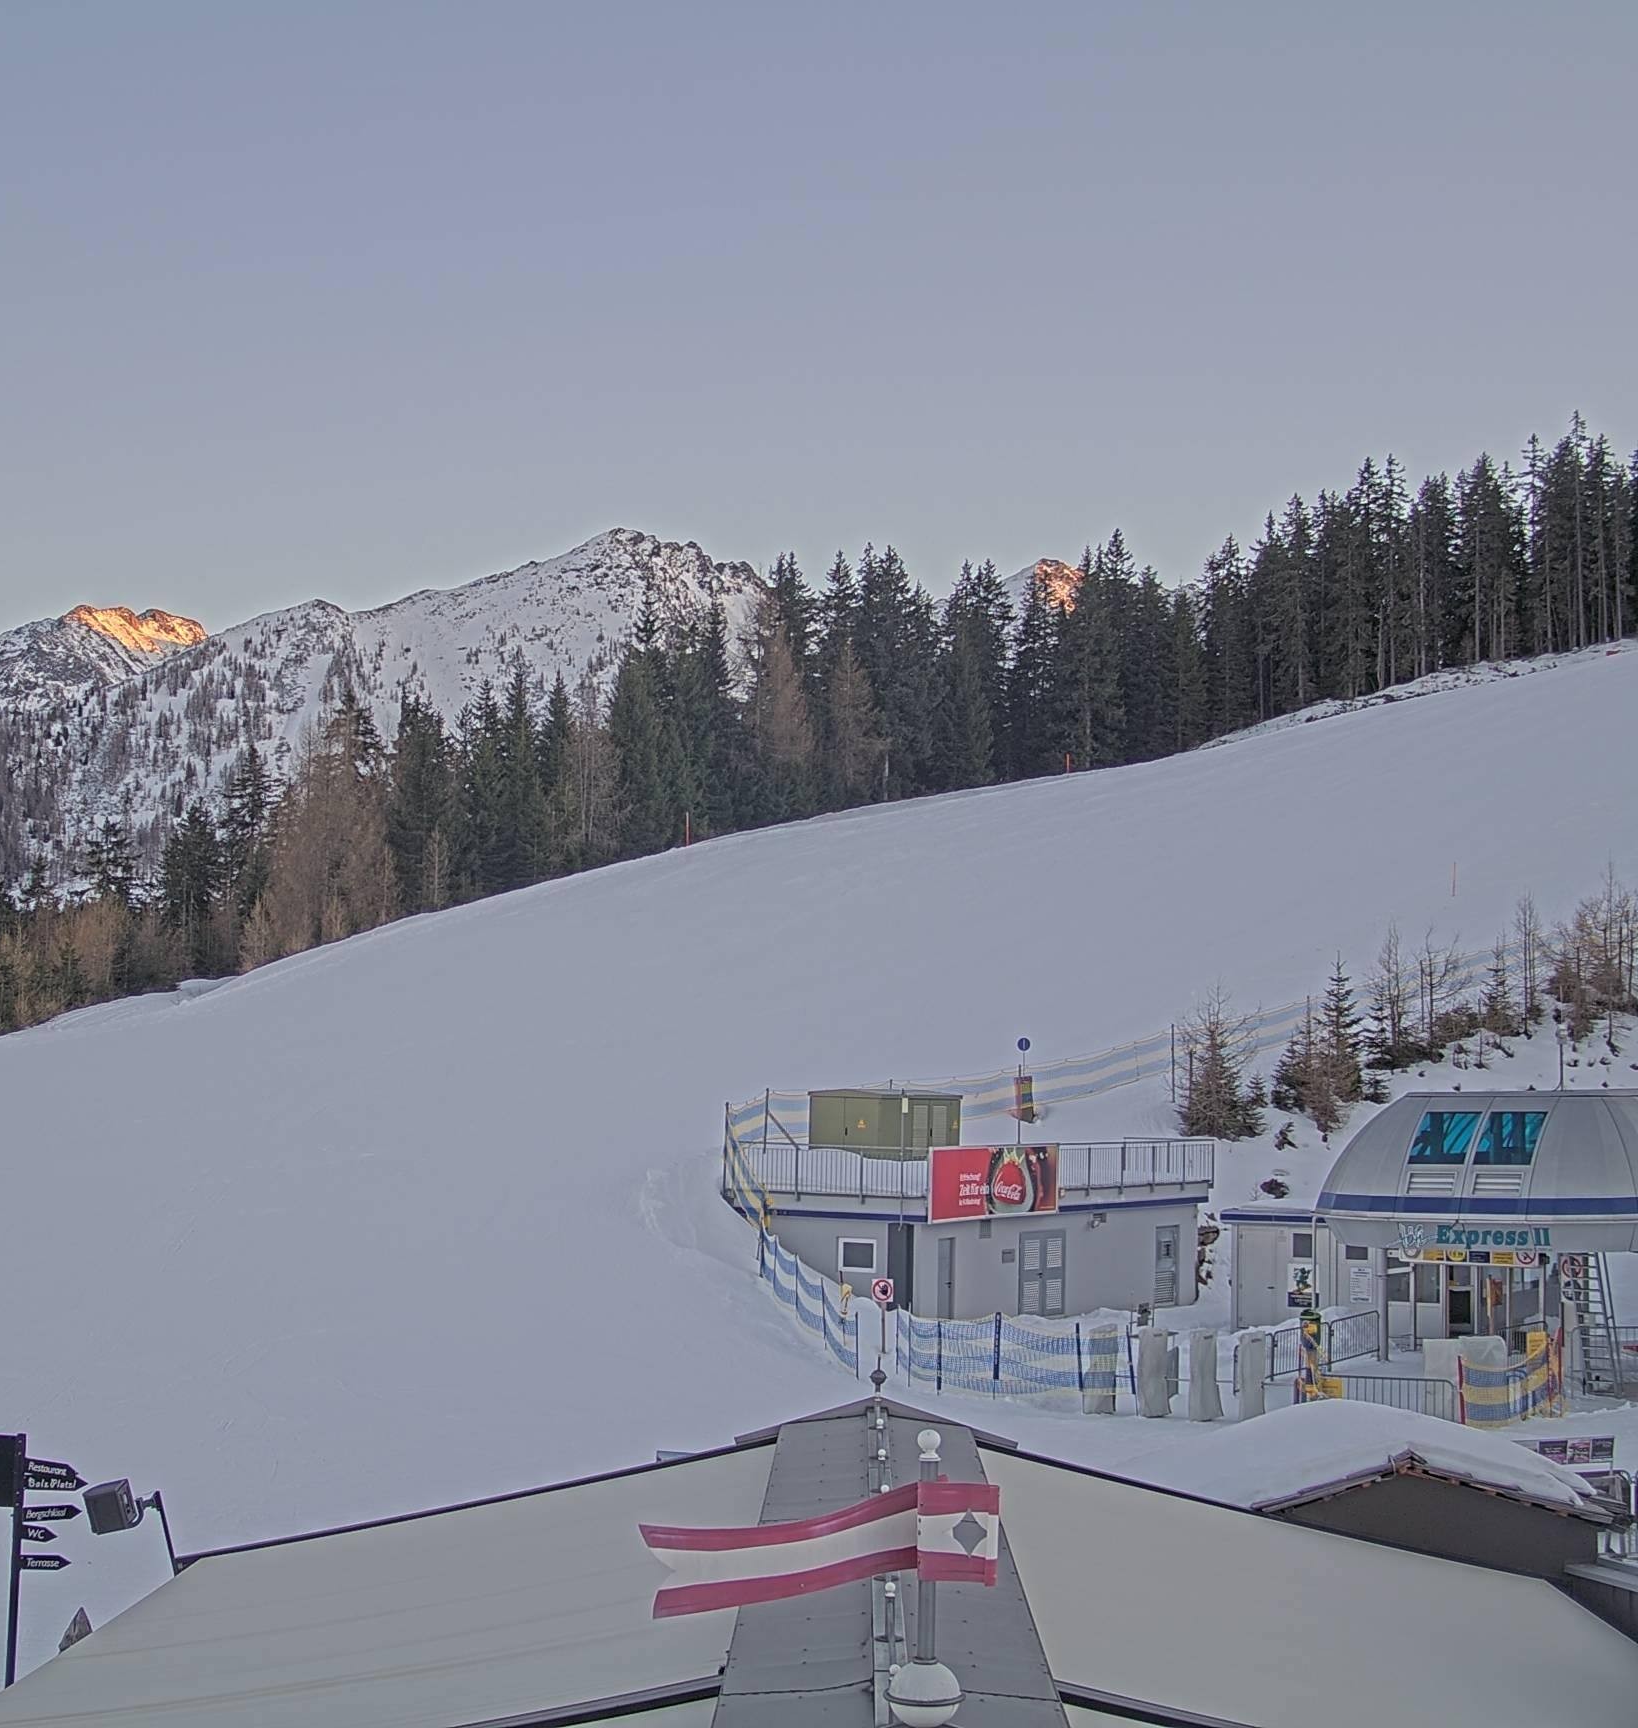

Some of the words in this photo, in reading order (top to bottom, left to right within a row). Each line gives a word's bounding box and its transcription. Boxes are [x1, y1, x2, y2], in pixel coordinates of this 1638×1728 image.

[1436, 1224, 1529, 1250] Express
[1533, 1227, 1551, 1247] II
[28, 1460, 67, 1477] Restaurant
[27, 1527, 46, 1539] WC
[26, 1557, 60, 1568] Terrasse
